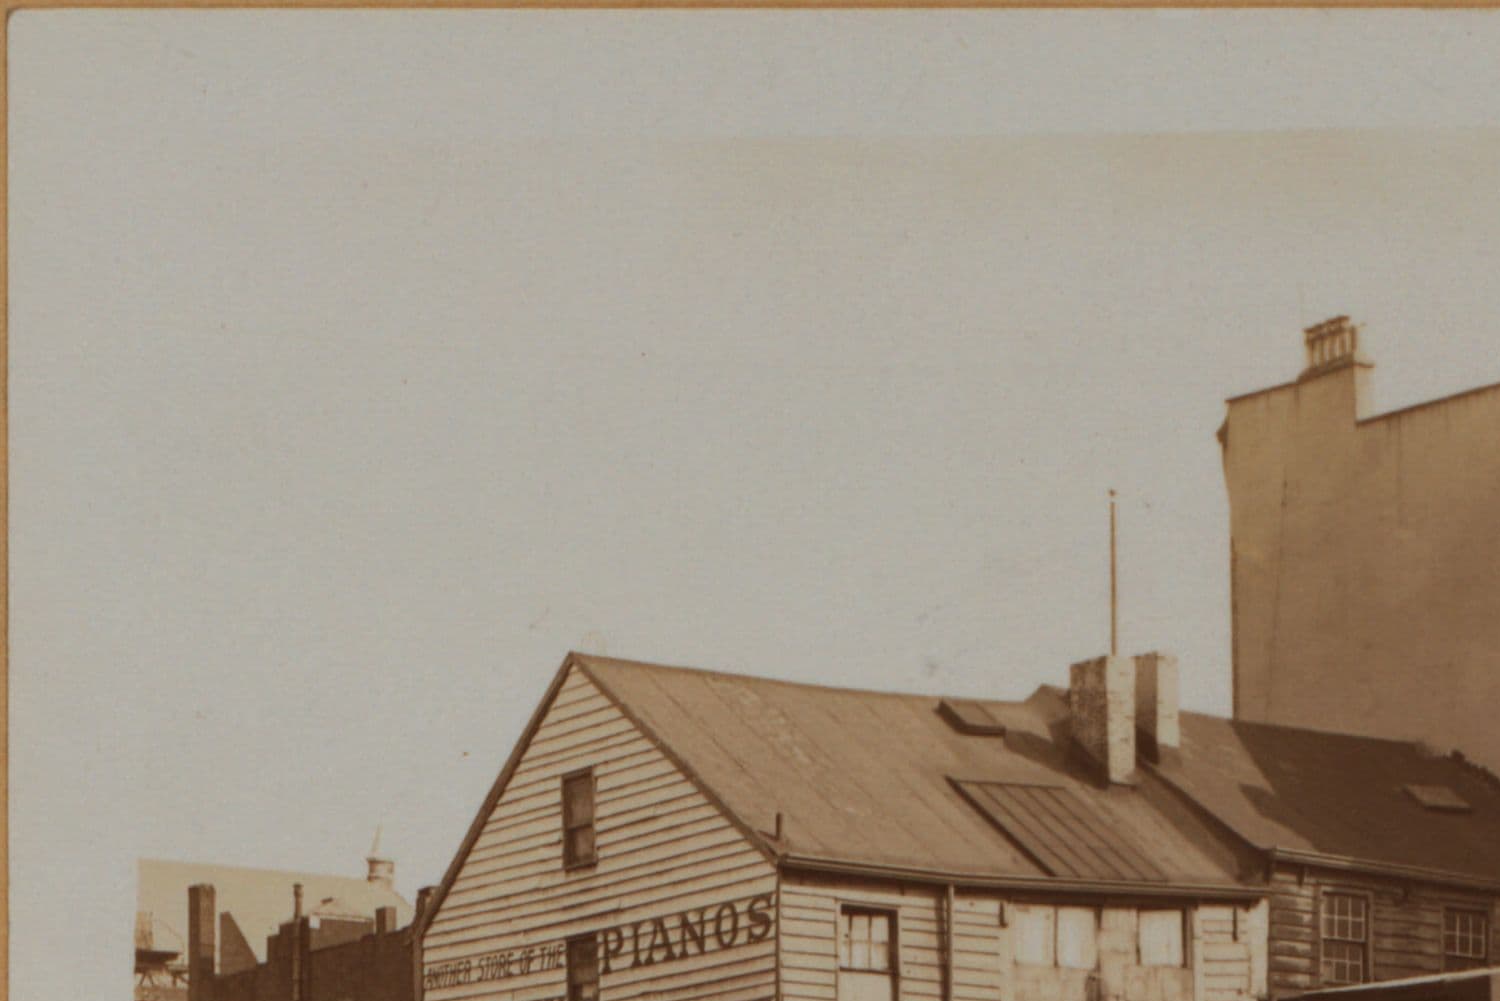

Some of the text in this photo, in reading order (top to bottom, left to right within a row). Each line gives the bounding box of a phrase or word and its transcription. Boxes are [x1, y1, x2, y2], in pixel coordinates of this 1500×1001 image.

[600, 896, 772, 974] PIANOS
[424, 944, 564, 989] ANOTHER STORE OF THE
